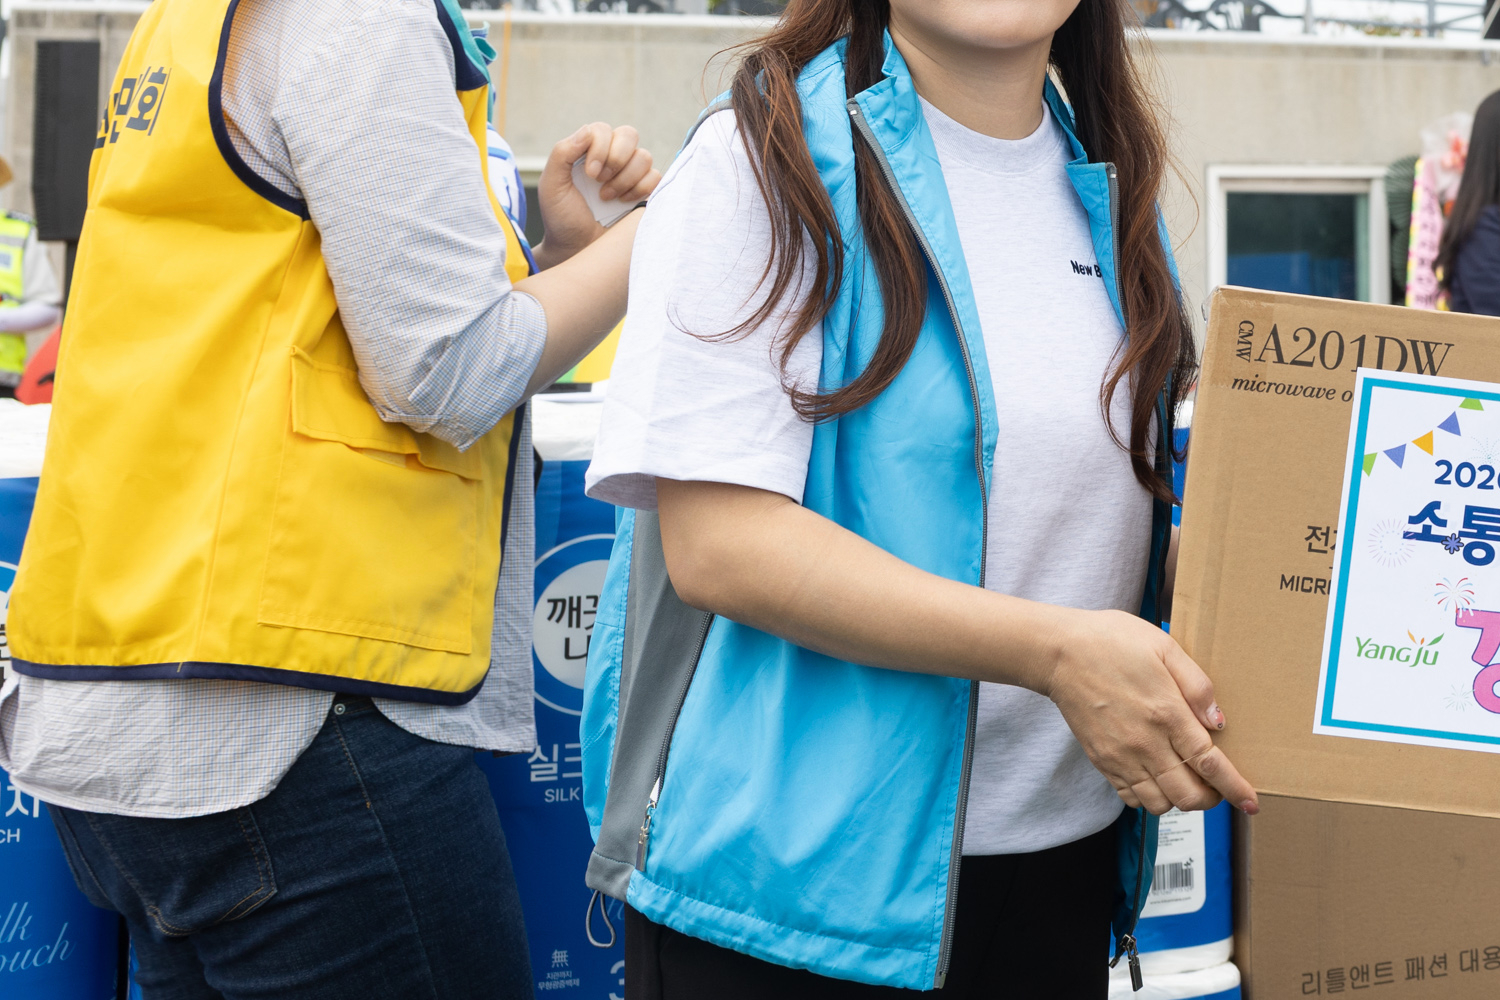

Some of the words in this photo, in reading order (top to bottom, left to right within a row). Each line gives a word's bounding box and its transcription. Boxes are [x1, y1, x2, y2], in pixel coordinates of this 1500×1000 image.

[1070, 260, 1092, 276] New
[1236, 320, 1255, 363] CMW
[1254, 323, 1455, 376] A201DW
[1231, 374, 1336, 401] microwave
[544, 787, 580, 803] SILK
[1302, 961, 1395, 996] 리틀앤트
[1405, 952, 1449, 982] 패션
